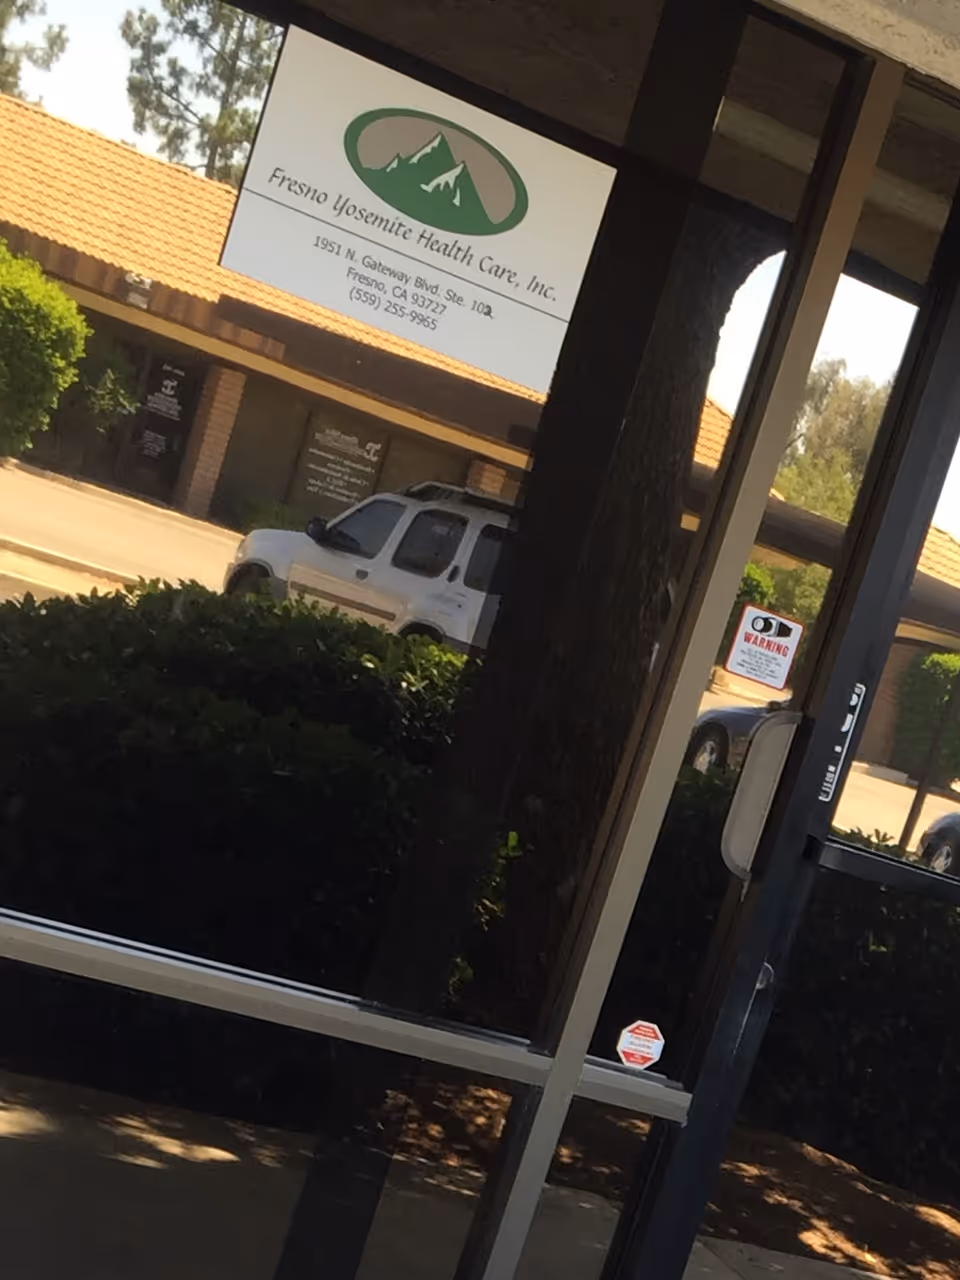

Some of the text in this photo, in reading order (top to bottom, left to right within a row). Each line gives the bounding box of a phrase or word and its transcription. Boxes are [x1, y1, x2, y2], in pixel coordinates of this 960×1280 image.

[268, 167, 556, 301] Fresno Yosemite Health Care, Inc.
[313, 236, 342, 256] 1951
[345, 248, 358, 263] N.
[361, 254, 411, 285] Gateway
[414, 276, 441, 297] Blvd.
[444, 288, 466, 307] Ste.
[346, 267, 447, 315] Fresno, CA 93727
[349, 286, 438, 331] (559) 255-9965
[744, 631, 789, 657] WARNING
